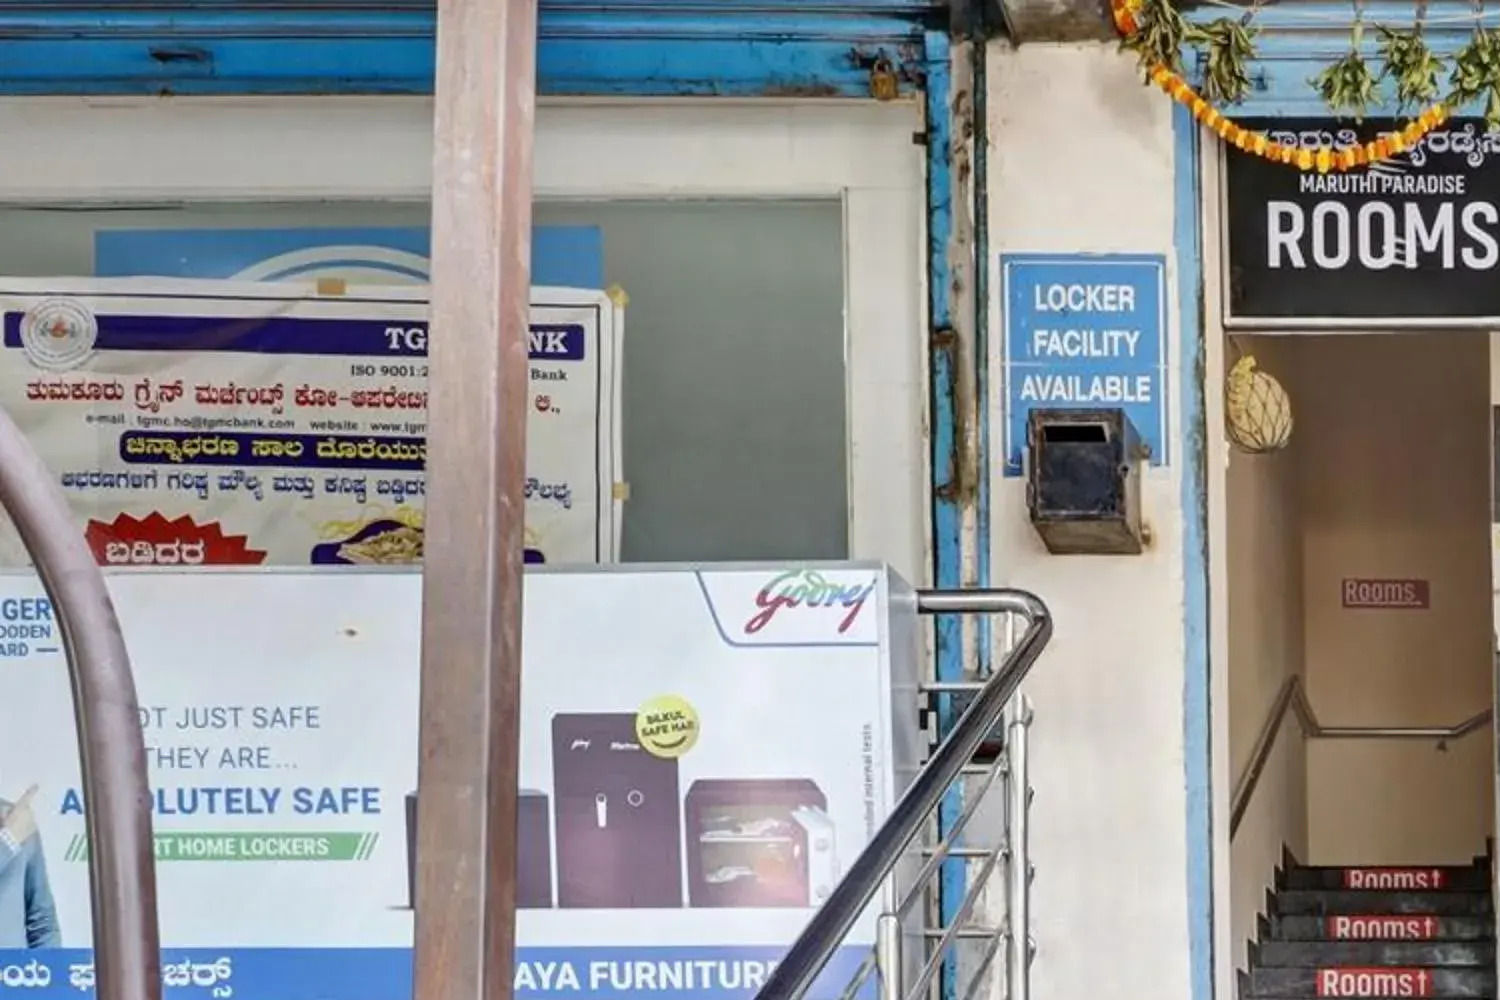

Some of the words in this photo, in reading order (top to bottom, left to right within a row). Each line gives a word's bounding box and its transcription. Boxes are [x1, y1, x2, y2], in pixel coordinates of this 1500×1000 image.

[1300, 175, 1377, 194] MARUTHI
[1382, 175, 1466, 194] PARADISE
[1267, 201, 1500, 270] ROOMS
[1035, 285, 1135, 311] LOCKER
[385, 327, 428, 350] TG
[529, 332, 568, 353] NK
[1034, 331, 1139, 356] FACILITY
[531, 368, 567, 381] Bank
[1021, 376, 1151, 402] AVAILABLE
[744, 570, 877, 634] Godrej
[1345, 580, 1416, 600] Rooms
[176, 706, 243, 729] JUST
[252, 706, 320, 729] SAFE
[292, 788, 381, 814] SAFE
[178, 839, 237, 855] HOME
[241, 838, 329, 856] LOCKERS
[1349, 869, 1428, 889] Rooms
[1335, 916, 1420, 938] Rooms
[1323, 970, 1412, 997] Rooms
